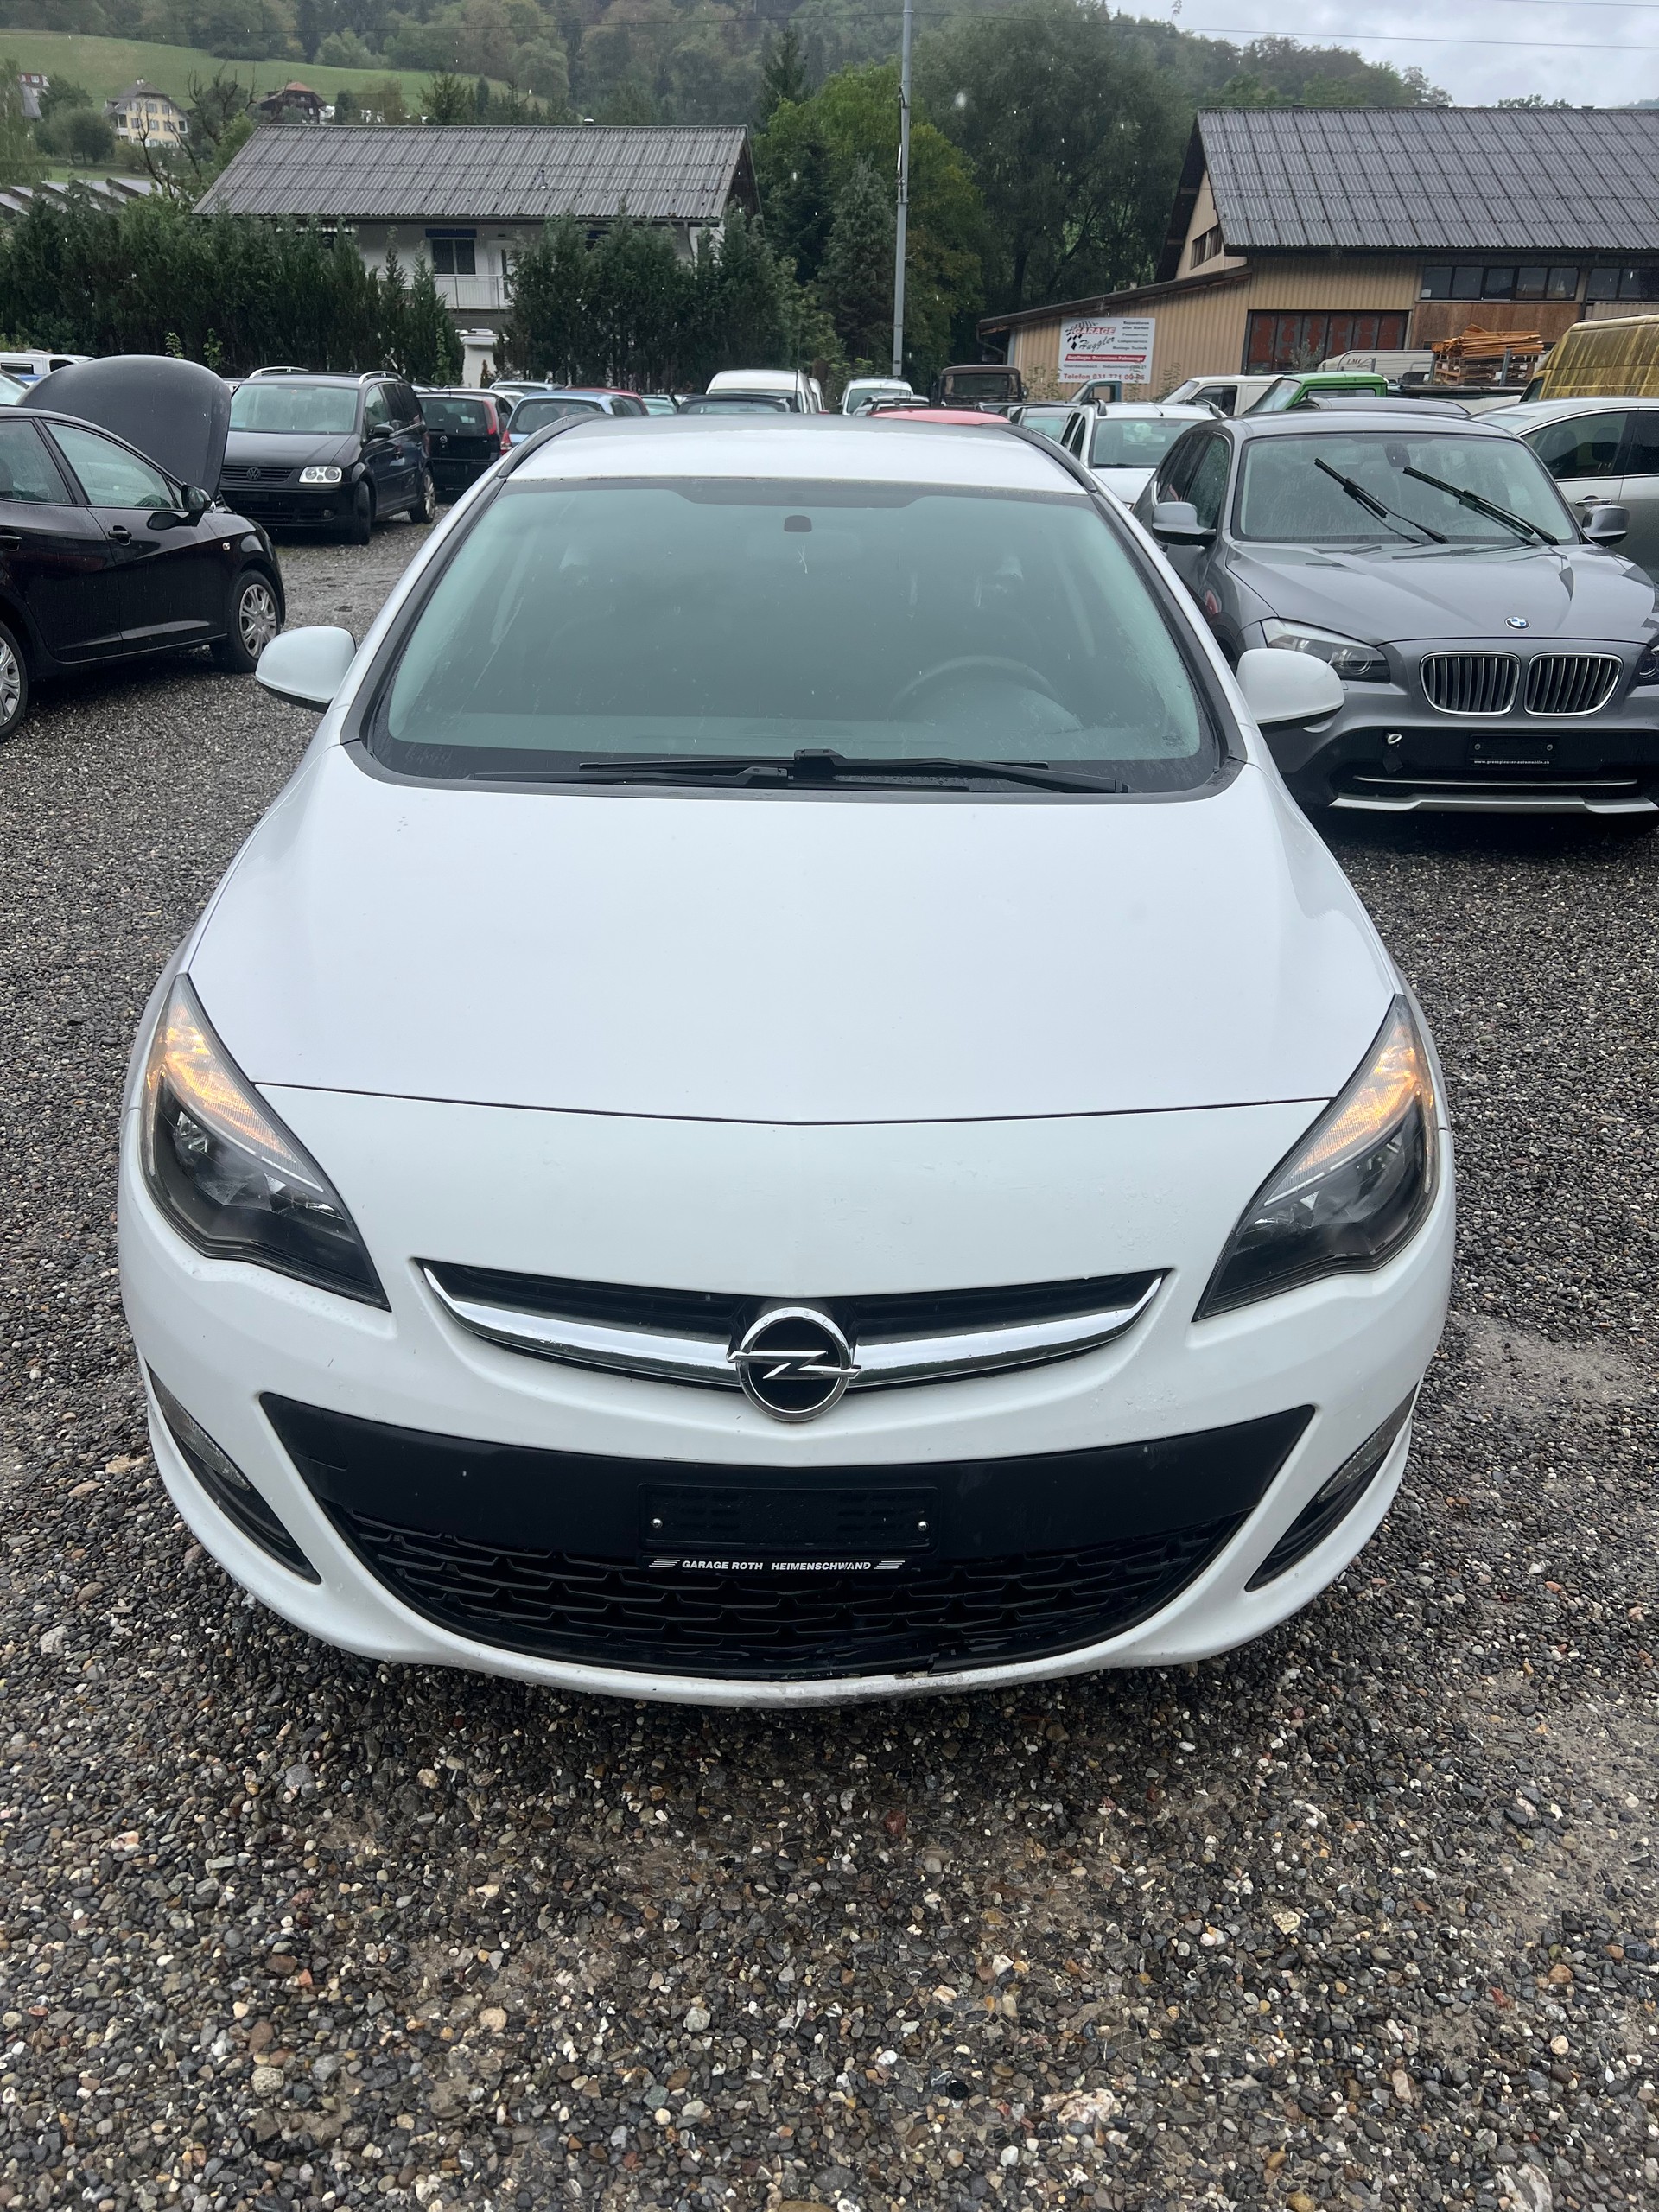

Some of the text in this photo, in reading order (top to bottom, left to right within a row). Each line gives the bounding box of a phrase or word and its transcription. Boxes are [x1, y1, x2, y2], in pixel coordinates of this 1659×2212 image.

[761, 1310, 828, 1327] OPEL
[682, 1560, 872, 1571] GARAGE ROTH HEIMENSCHWAND
